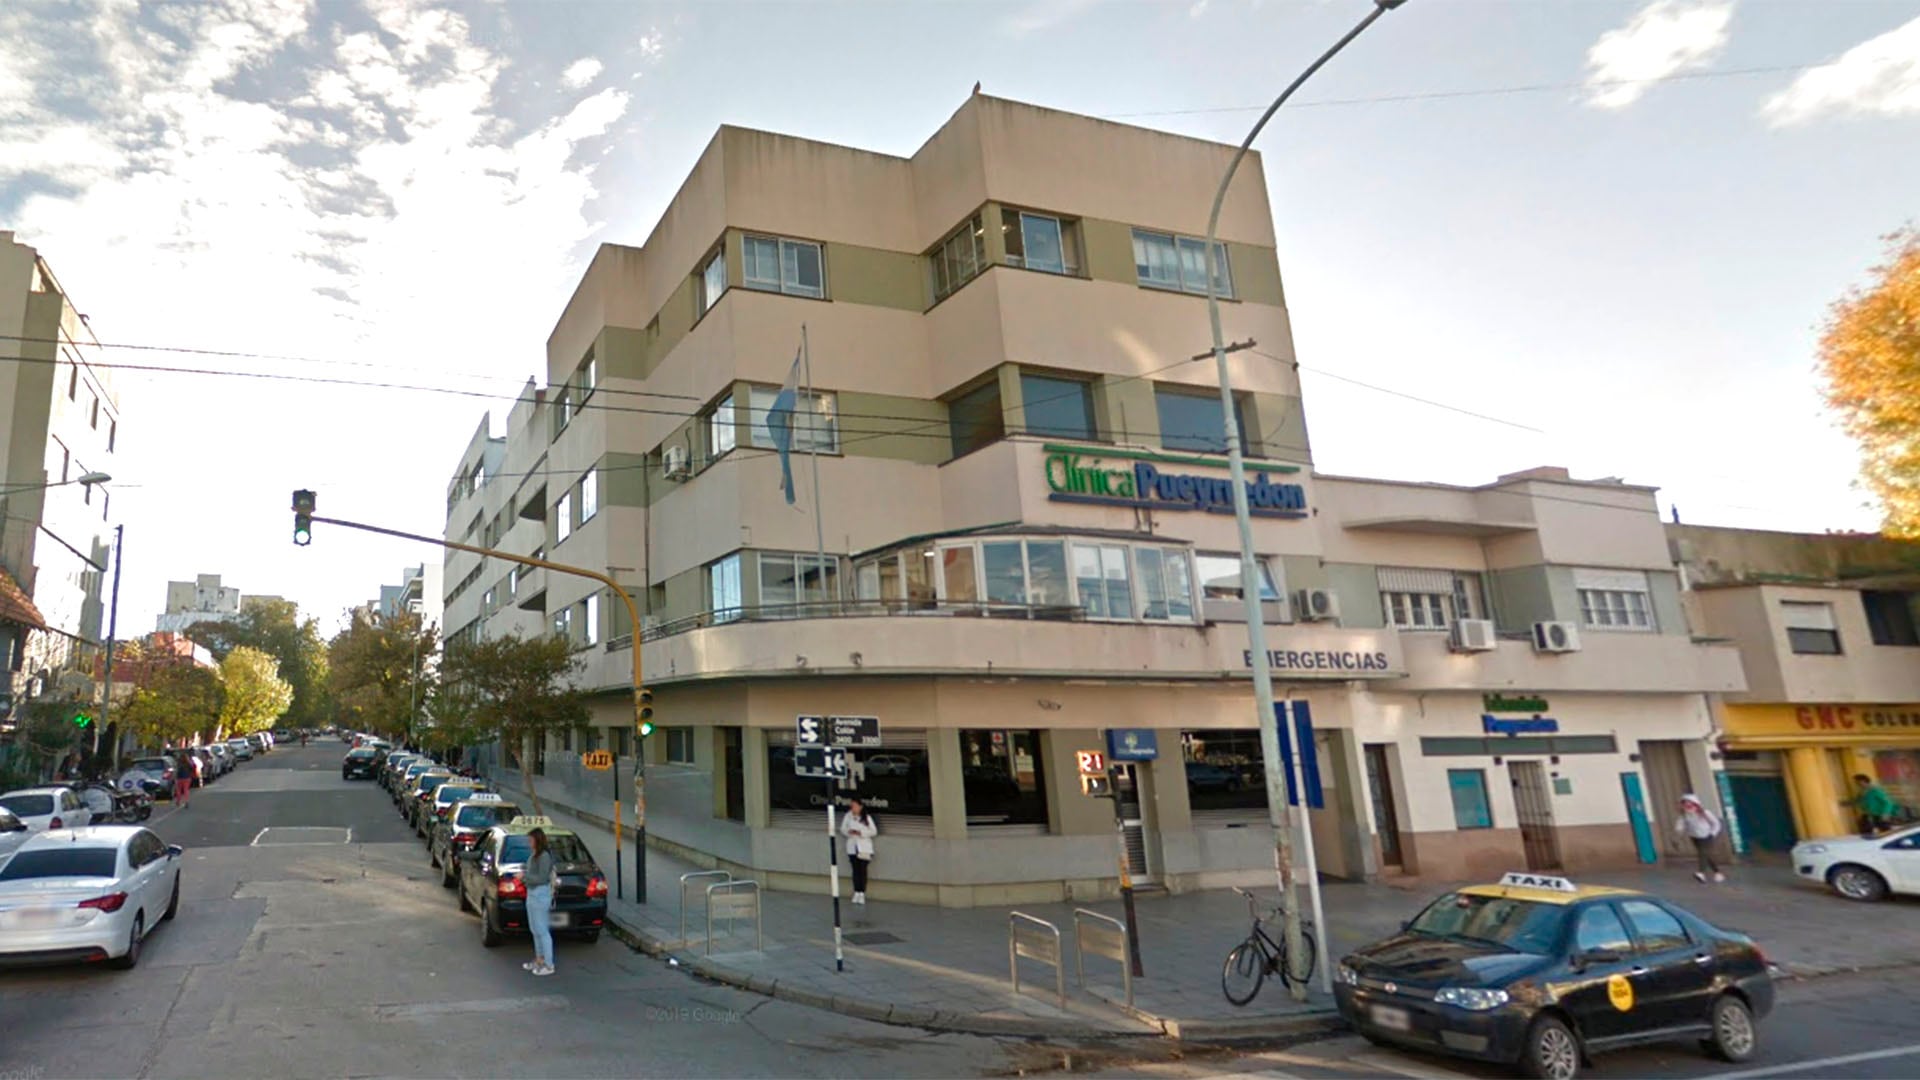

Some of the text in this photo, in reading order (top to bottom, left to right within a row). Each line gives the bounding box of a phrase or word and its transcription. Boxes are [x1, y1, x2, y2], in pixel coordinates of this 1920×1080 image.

[1045, 455, 1134, 498] Clínica
[1796, 704, 1855, 730] GNC
[585, 753, 609, 767] TAXI
[1508, 875, 1562, 889] TAXI
